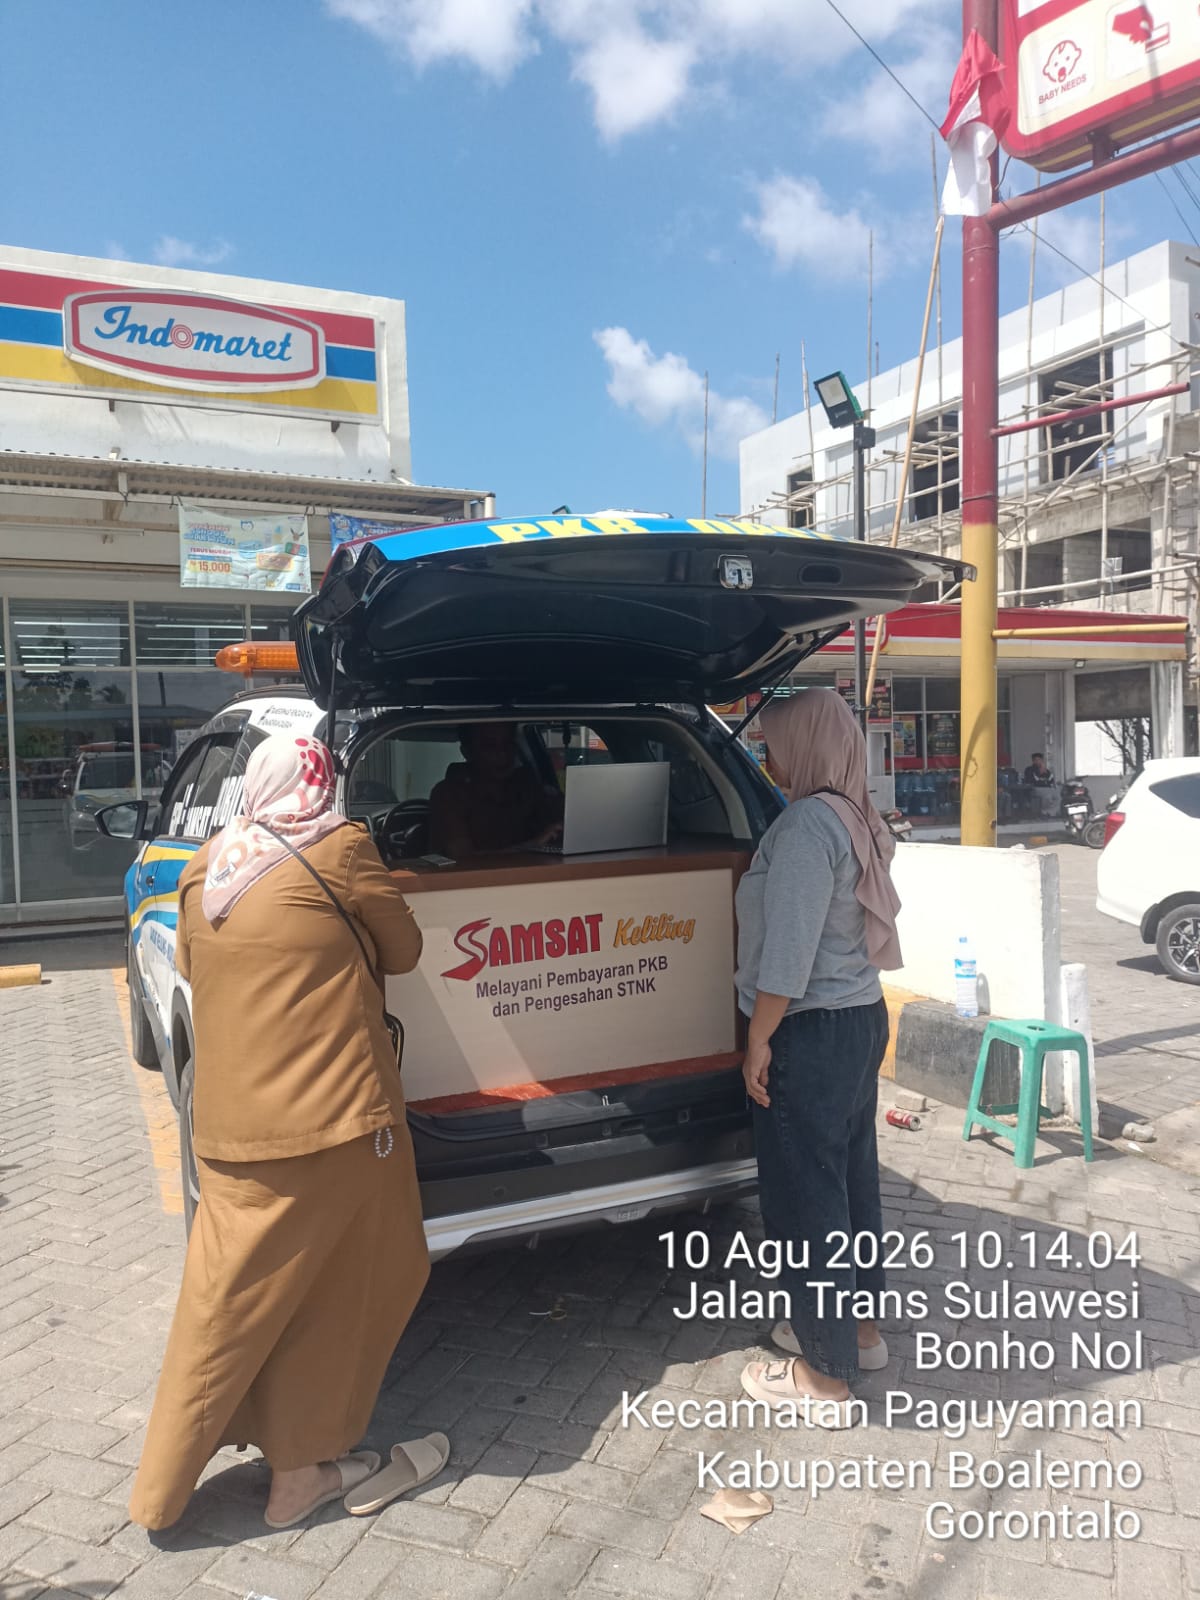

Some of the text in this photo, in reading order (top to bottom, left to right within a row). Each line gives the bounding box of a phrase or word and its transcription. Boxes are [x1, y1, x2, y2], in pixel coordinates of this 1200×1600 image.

[1038, 74, 1087, 105] BABY NEEDS
[94, 305, 292, 361] Indomaret
[199, 561, 232, 574] 15.000
[440, 912, 696, 981] SAMSAT Keliling
[476, 955, 669, 999] Melayani Pembayaran PKB
[492, 977, 656, 1018] dan Pengesahan STNK
